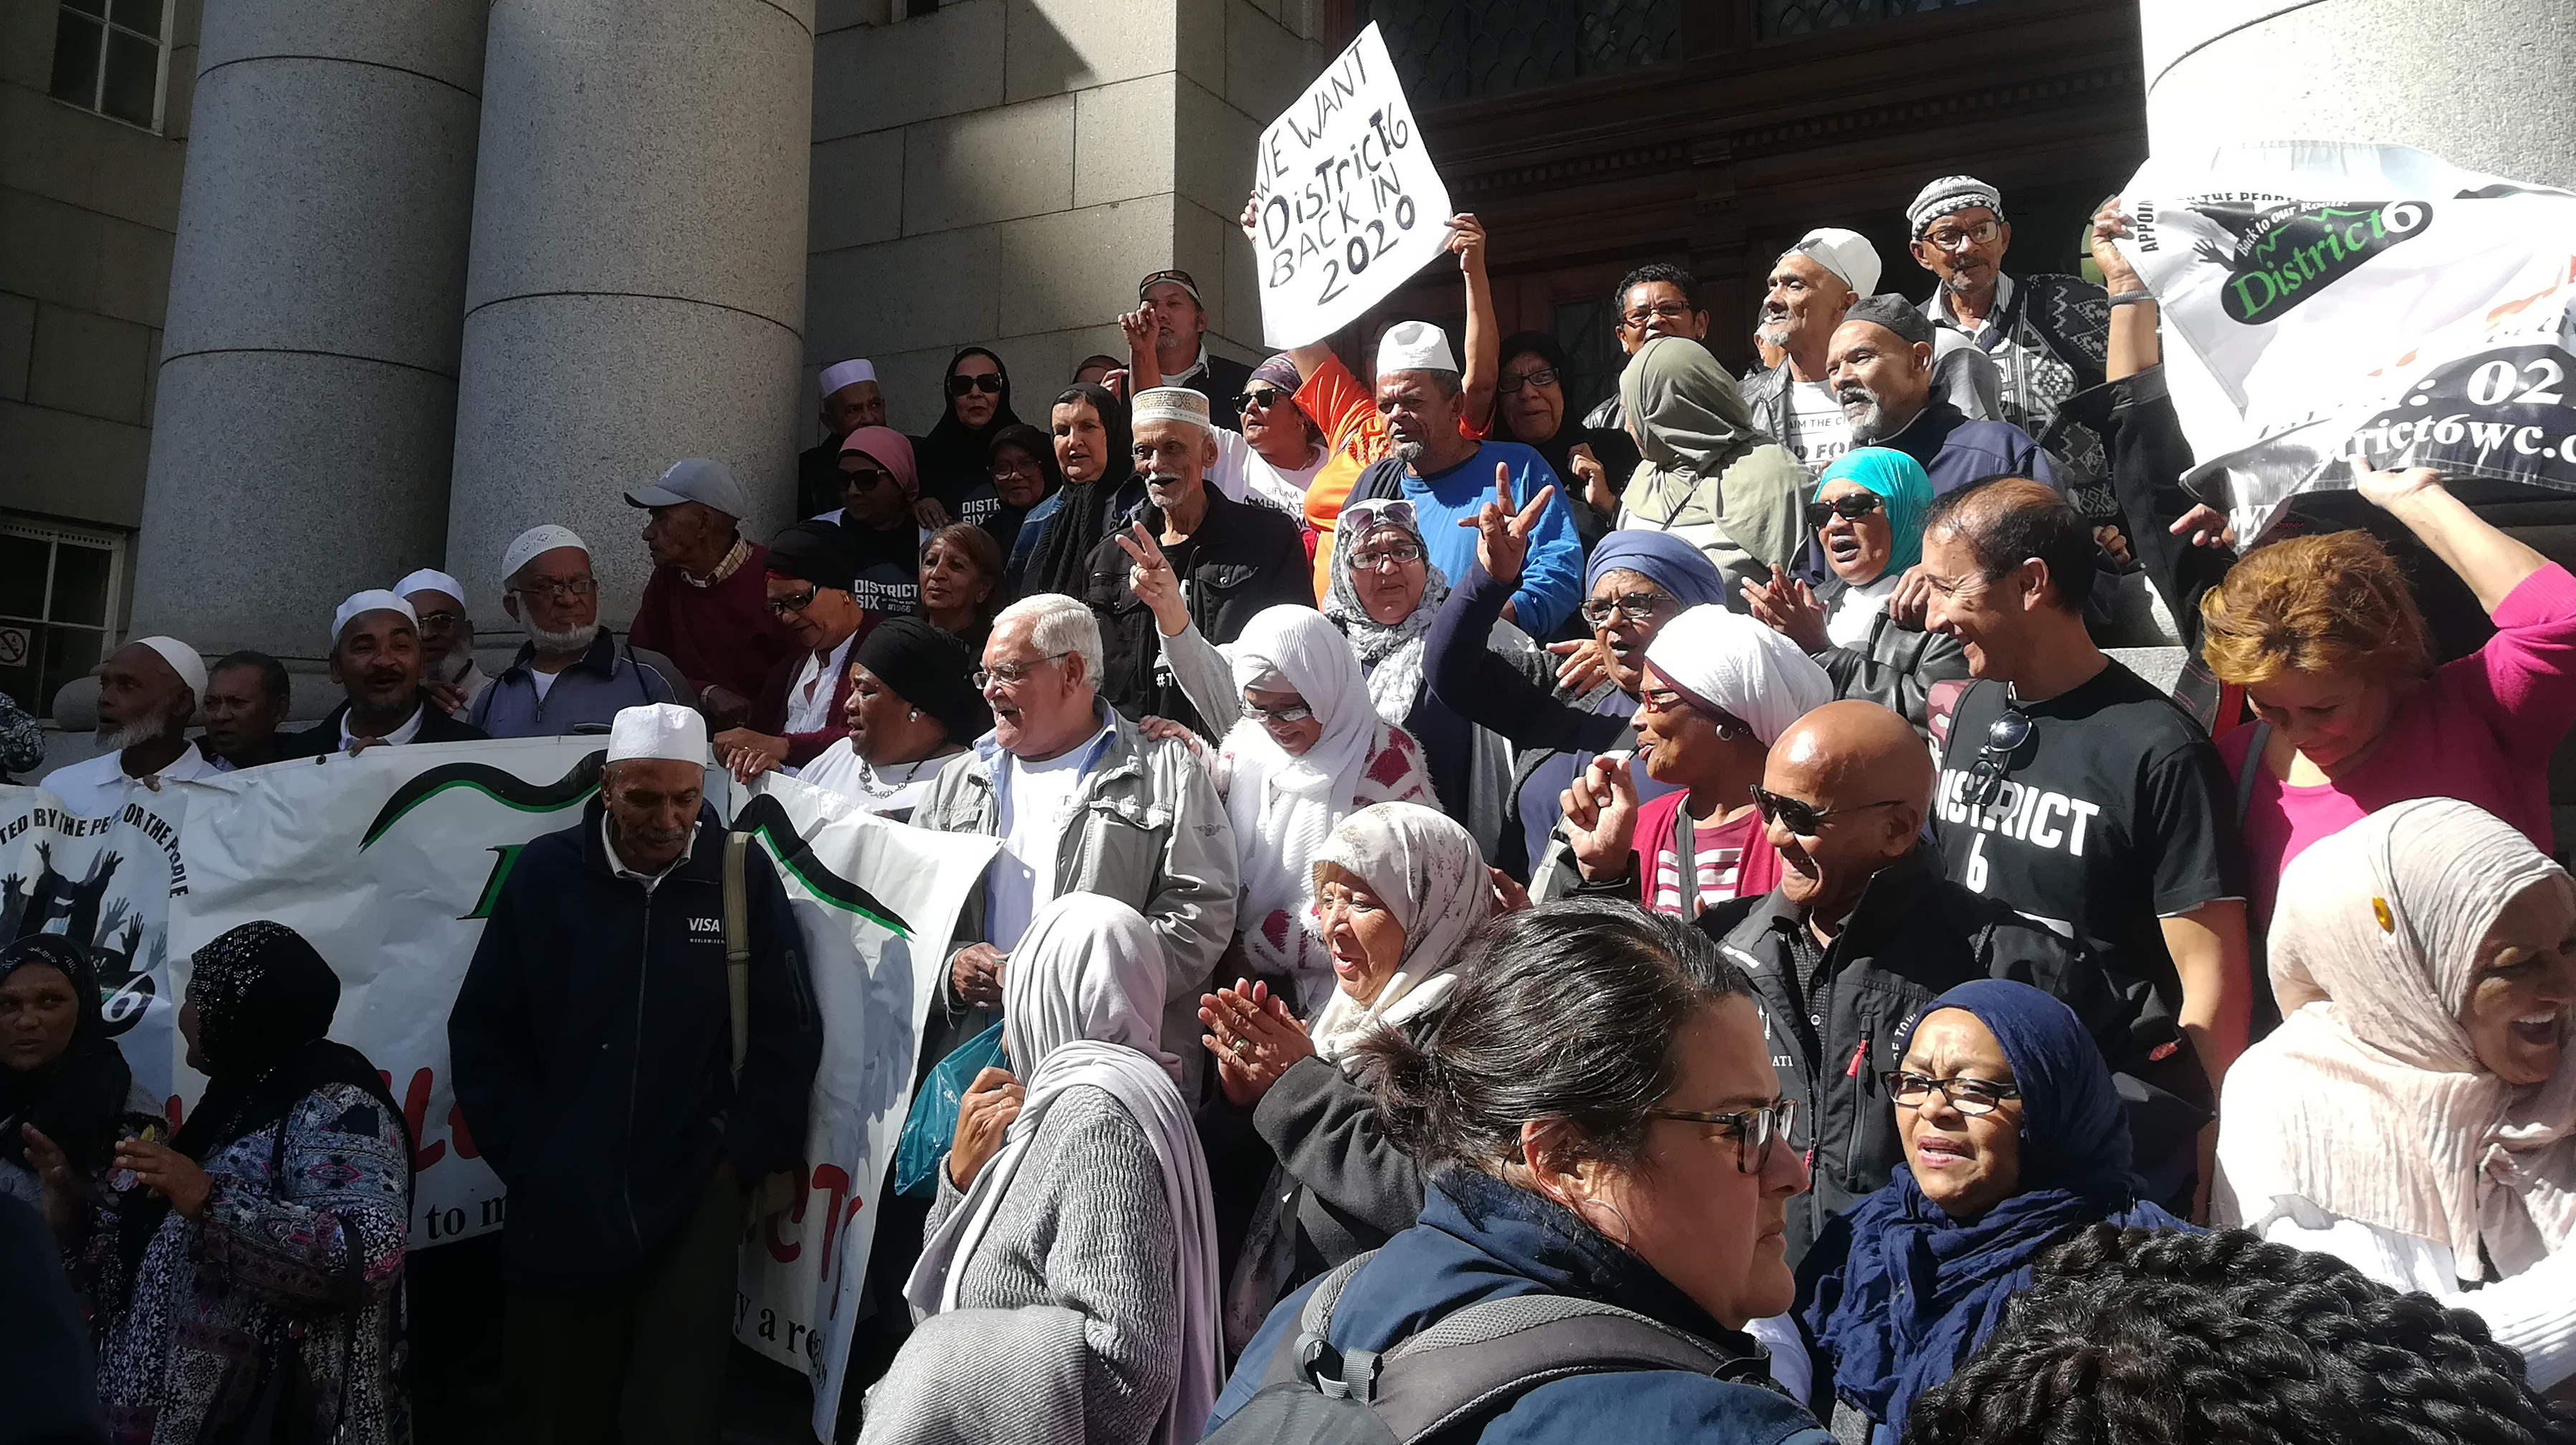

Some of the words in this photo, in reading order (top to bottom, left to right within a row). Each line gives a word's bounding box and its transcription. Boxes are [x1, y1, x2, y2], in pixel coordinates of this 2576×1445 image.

[1255, 128, 1289, 201] WE
[1288, 37, 1366, 148] WANT
[1270, 192, 1359, 288] BACK
[1318, 195, 1415, 305] 2020
[2235, 228, 2259, 256] Back
[2256, 219, 2270, 234] to
[2271, 206, 2297, 224] our
[1810, 418, 1832, 428] THE
[854, 579, 919, 598] DISTRICT
[856, 594, 880, 610] SIX
[34, 807, 57, 828] BY
[143, 812, 173, 846] THE
[1966, 832, 1989, 894] 6
[686, 917, 720, 933] VISA
[424, 1203, 466, 1241] to
